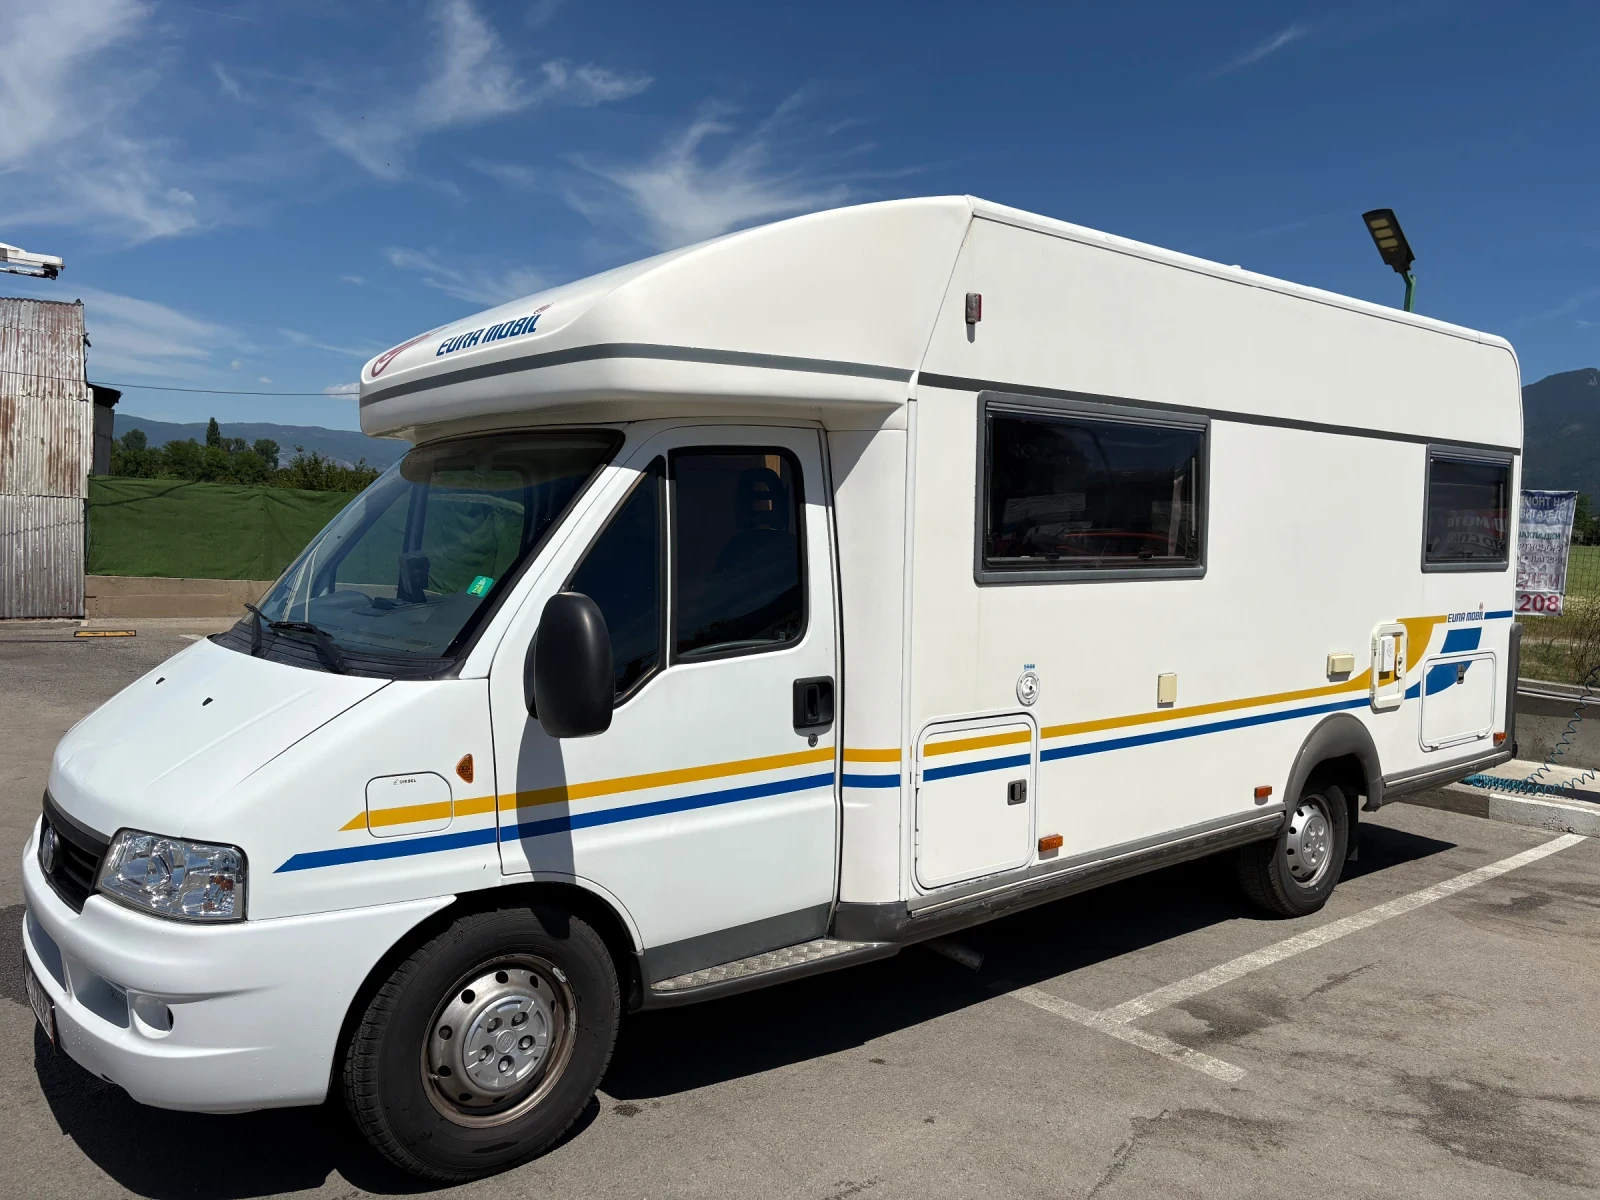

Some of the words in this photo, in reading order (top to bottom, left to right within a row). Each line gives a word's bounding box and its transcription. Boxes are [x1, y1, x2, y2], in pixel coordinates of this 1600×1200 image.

[436, 328, 486, 356] EURA
[481, 314, 542, 344] MOBIL
[1520, 496, 1551, 507] ЕМОНТ
[1518, 593, 1560, 612] 208
[1447, 612, 1466, 623] EURA
[1465, 611, 1484, 622] MOBIL
